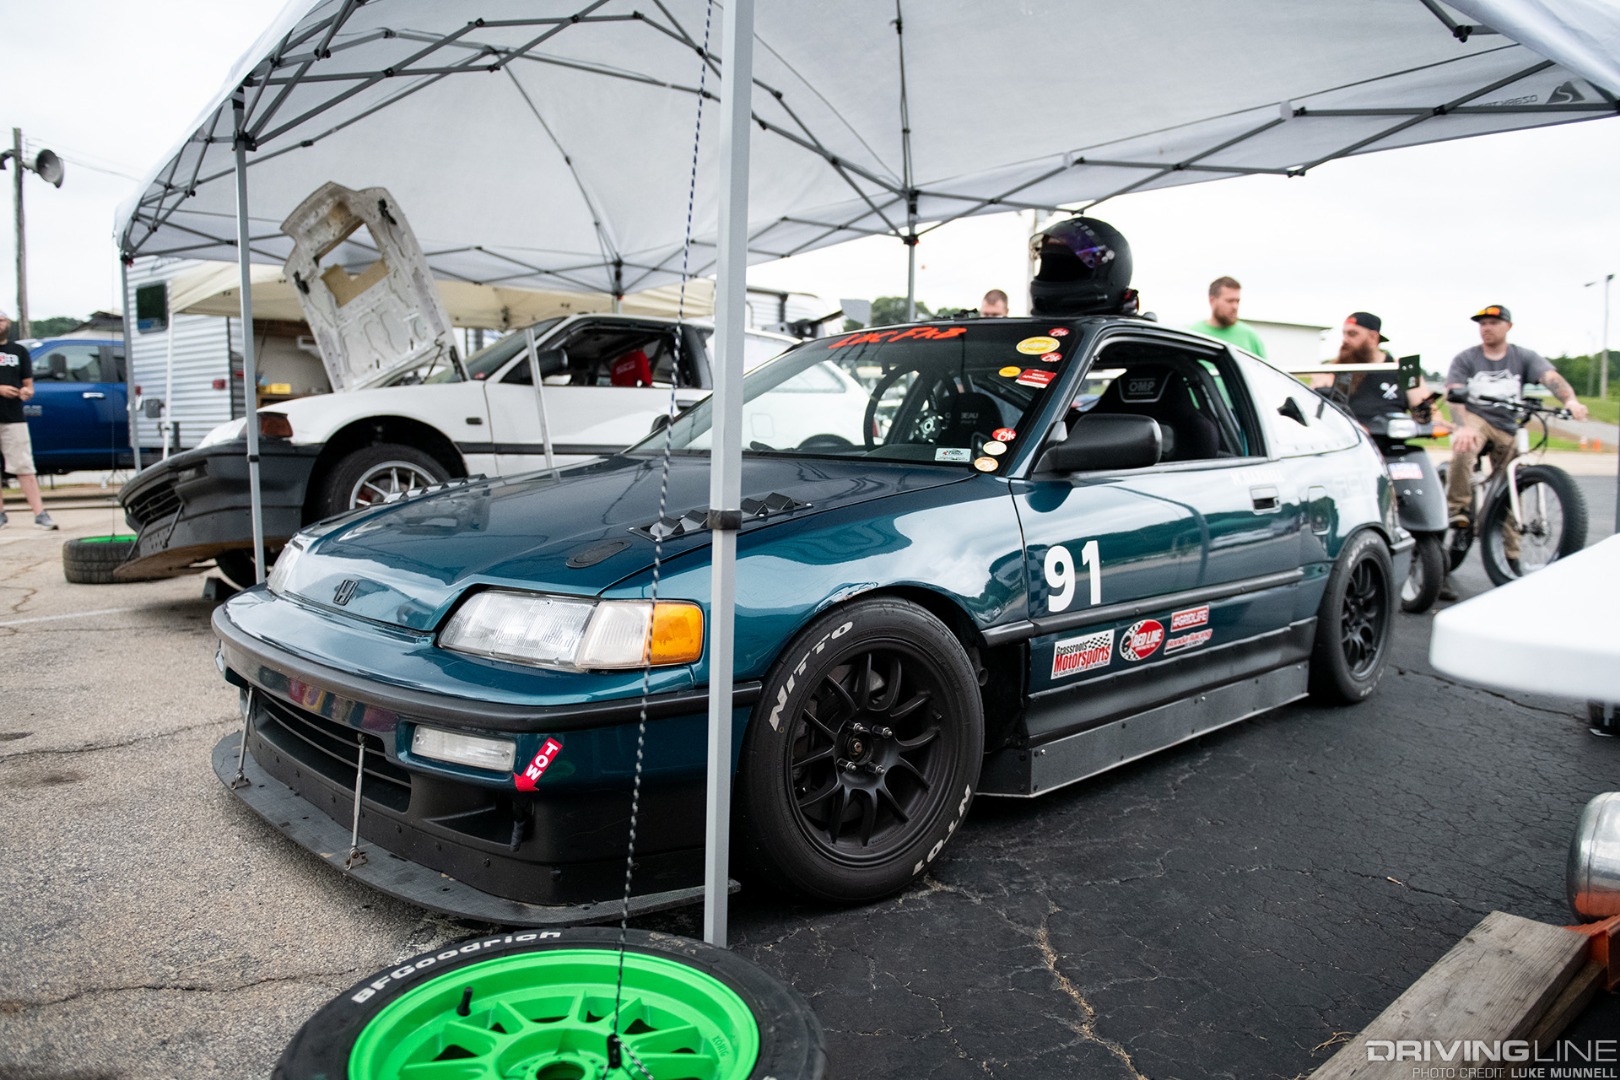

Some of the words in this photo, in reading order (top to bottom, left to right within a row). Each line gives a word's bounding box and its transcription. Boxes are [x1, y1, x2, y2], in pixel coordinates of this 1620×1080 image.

[1129, 381, 1155, 391] OMP
[997, 431, 1016, 441] Ok
[1044, 540, 1102, 613] 91
[1056, 642, 1087, 656] Grassroots
[1132, 632, 1147, 648] RED
[1146, 629, 1163, 644] LINE
[1053, 645, 1111, 672] Motorsports
[768, 621, 853, 731] NITTO
[525, 741, 559, 781] TOW
[351, 931, 561, 1003] BFGoodrich
